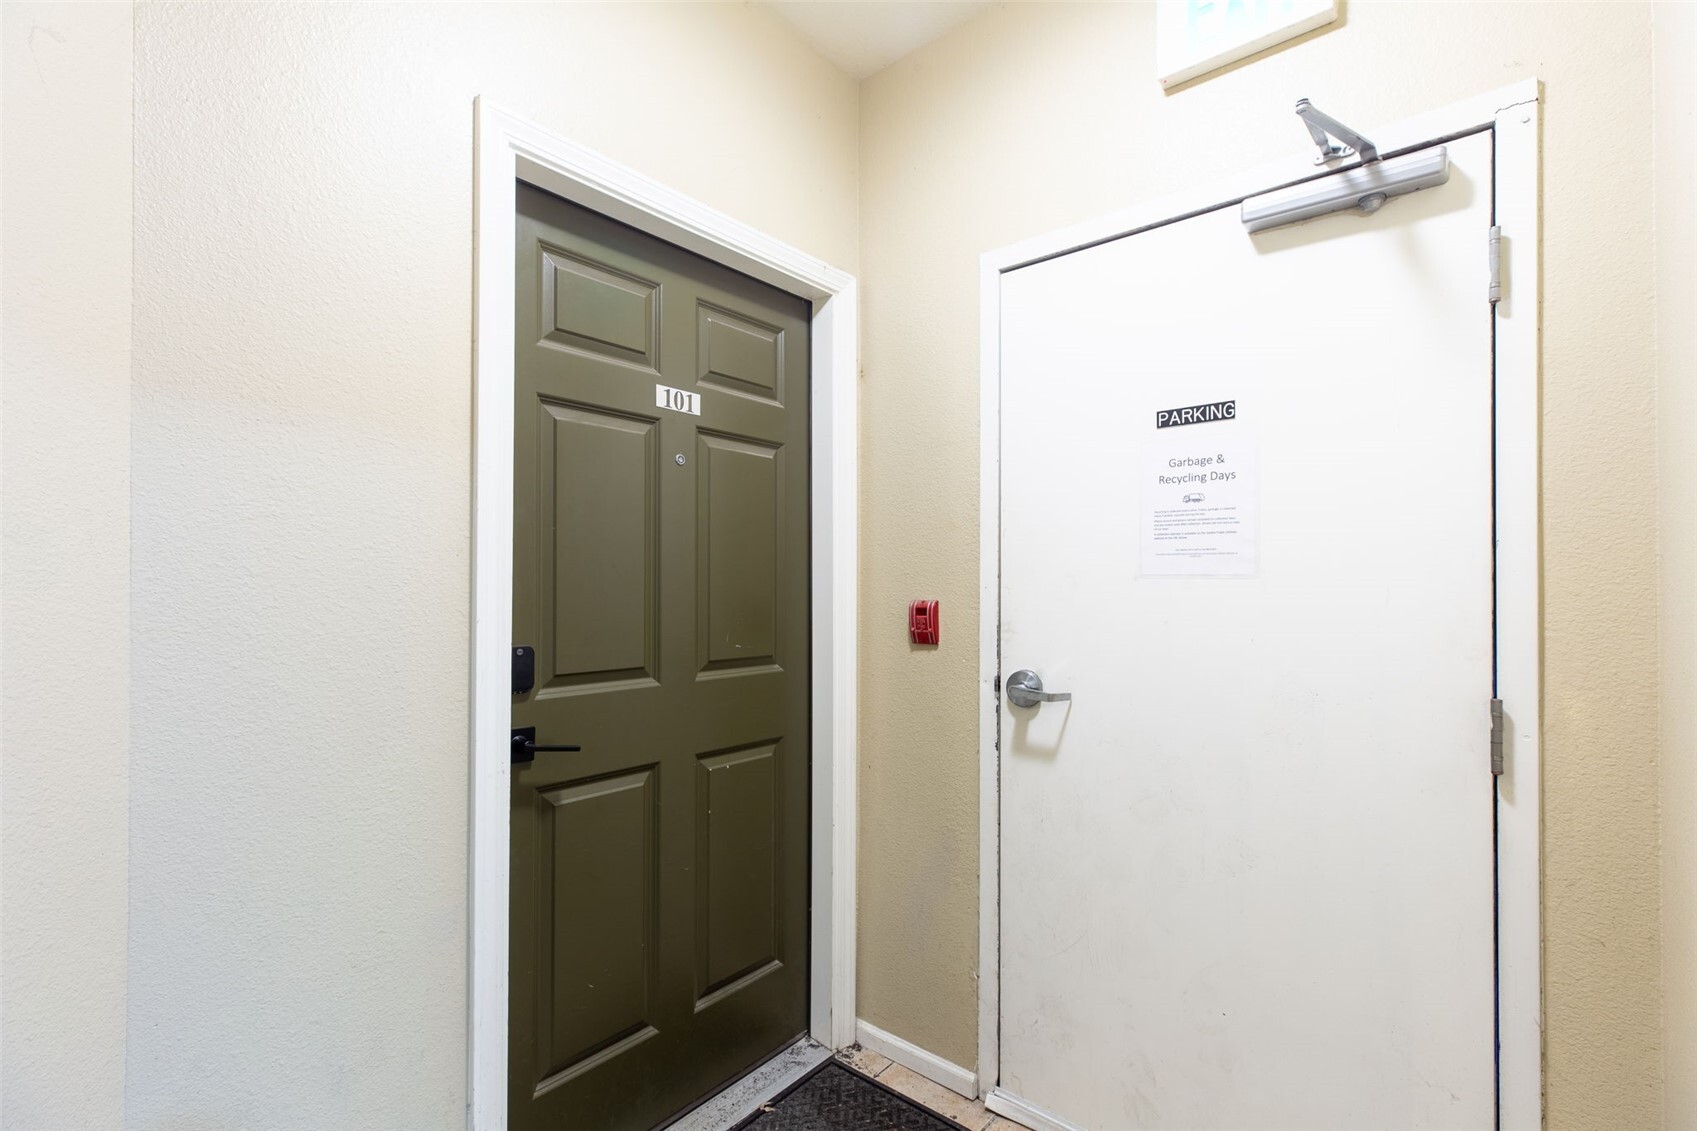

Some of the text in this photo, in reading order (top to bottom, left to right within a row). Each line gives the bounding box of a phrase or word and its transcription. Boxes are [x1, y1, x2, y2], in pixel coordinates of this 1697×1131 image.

[664, 388, 694, 414] 101
[1158, 401, 1235, 427] PARKING
[1168, 453, 1225, 468] Garbage &
[1158, 470, 1237, 485] Recycling Days
